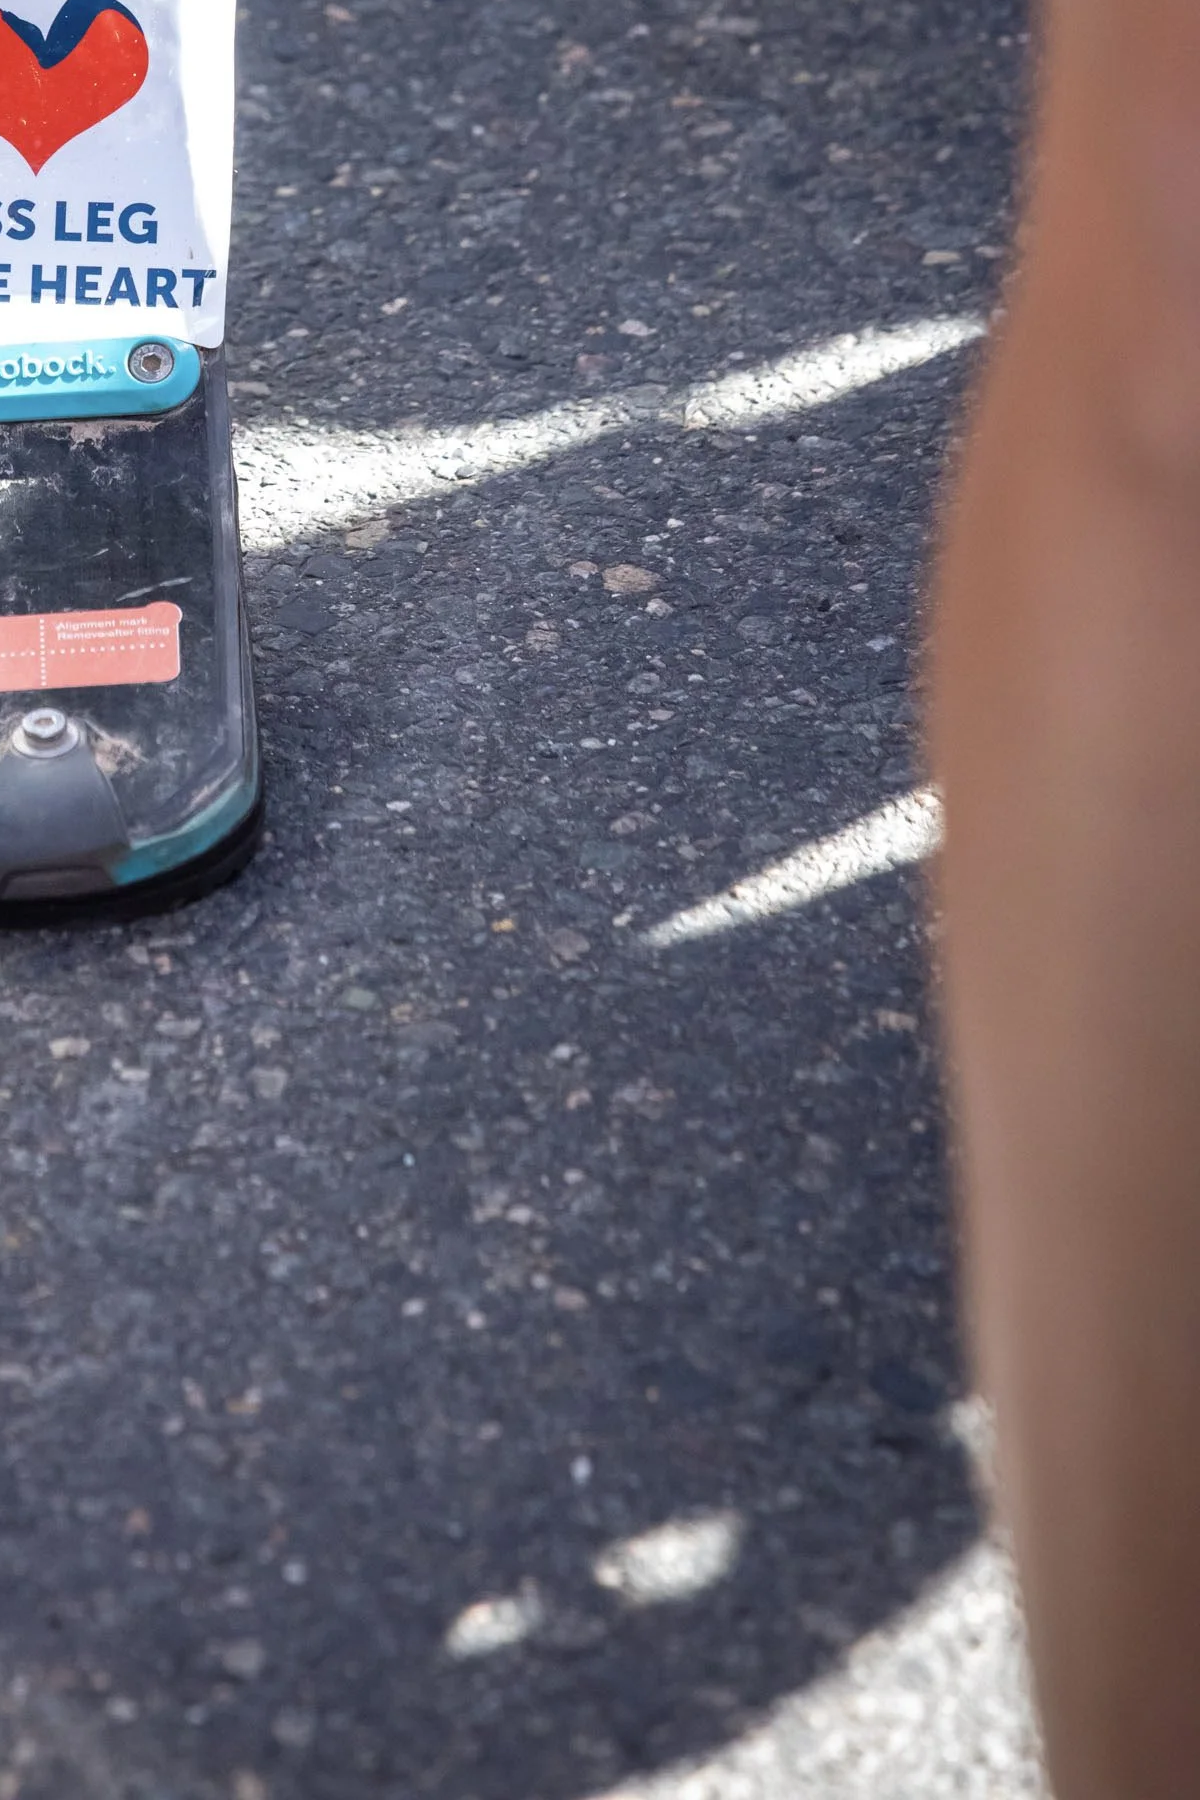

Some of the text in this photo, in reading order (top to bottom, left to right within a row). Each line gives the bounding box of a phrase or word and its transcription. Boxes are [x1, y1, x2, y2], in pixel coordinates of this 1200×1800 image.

[54, 200, 159, 244] LEG
[30, 263, 217, 308] HEART
[56, 616, 148, 631] Alignment mark
[137, 626, 170, 636] fitting
